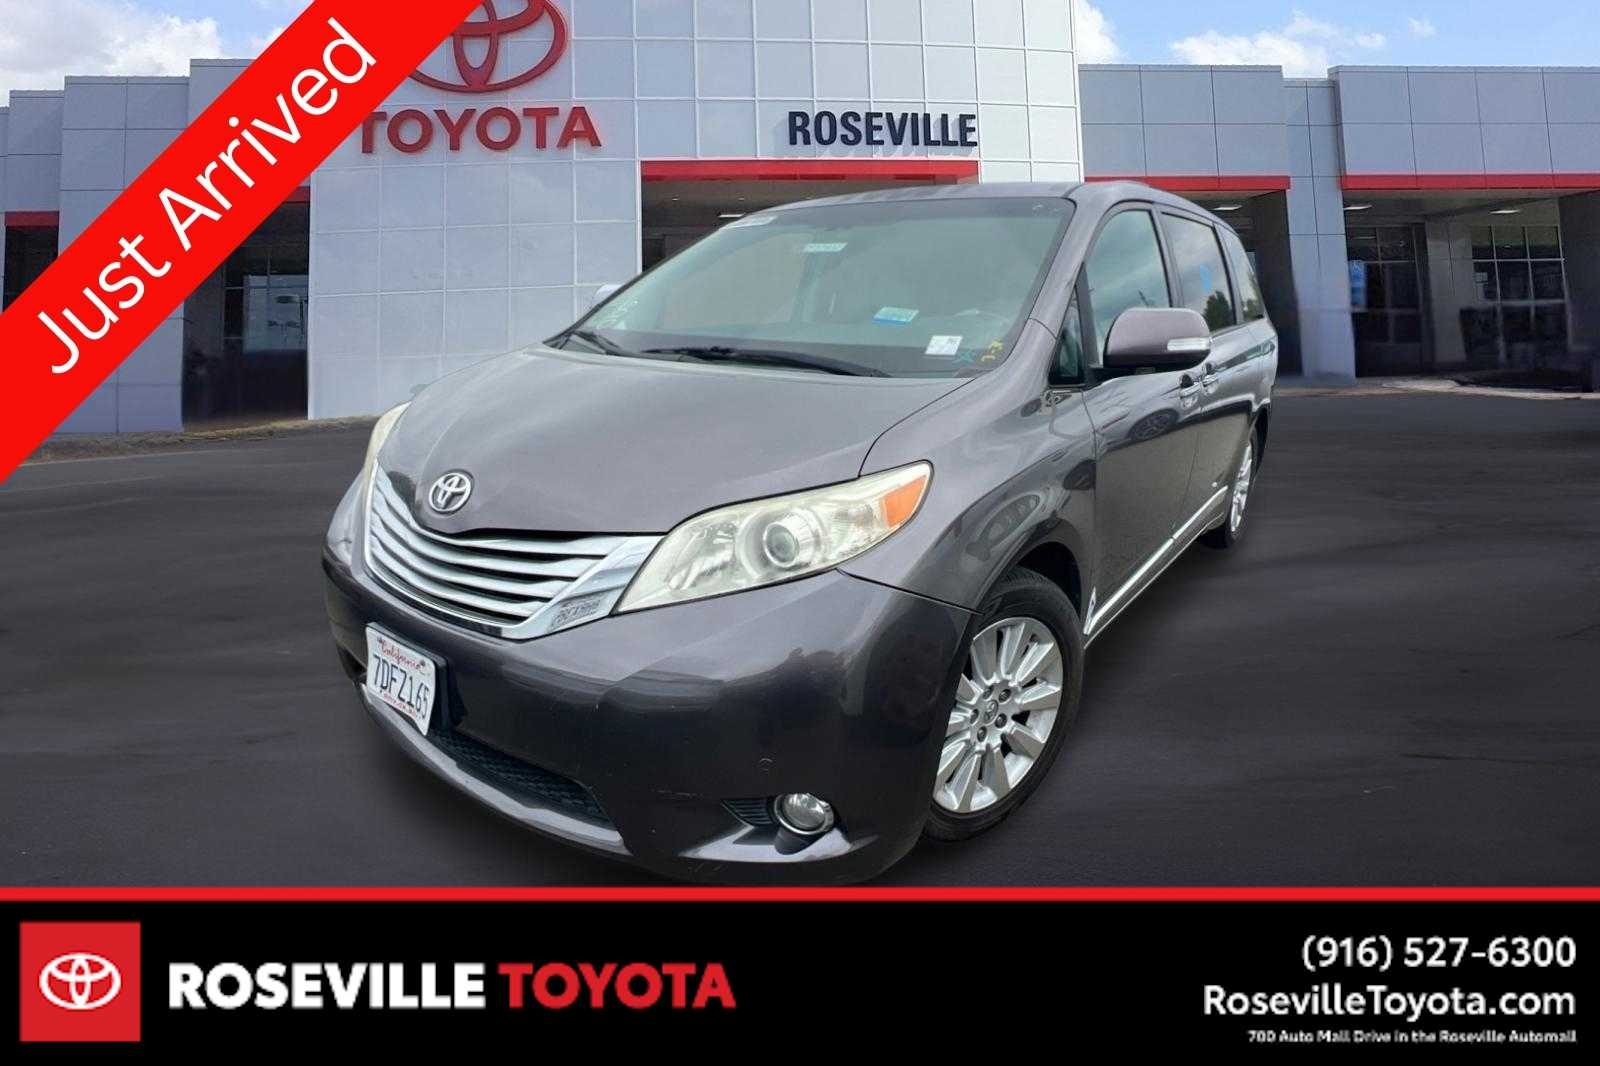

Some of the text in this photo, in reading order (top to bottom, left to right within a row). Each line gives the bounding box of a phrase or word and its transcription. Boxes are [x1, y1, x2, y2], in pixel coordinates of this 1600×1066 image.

[362, 106, 602, 154] TOYOTA
[788, 111, 978, 147] ROSEVILLE
[373, 654, 430, 720] 7DFZ165
